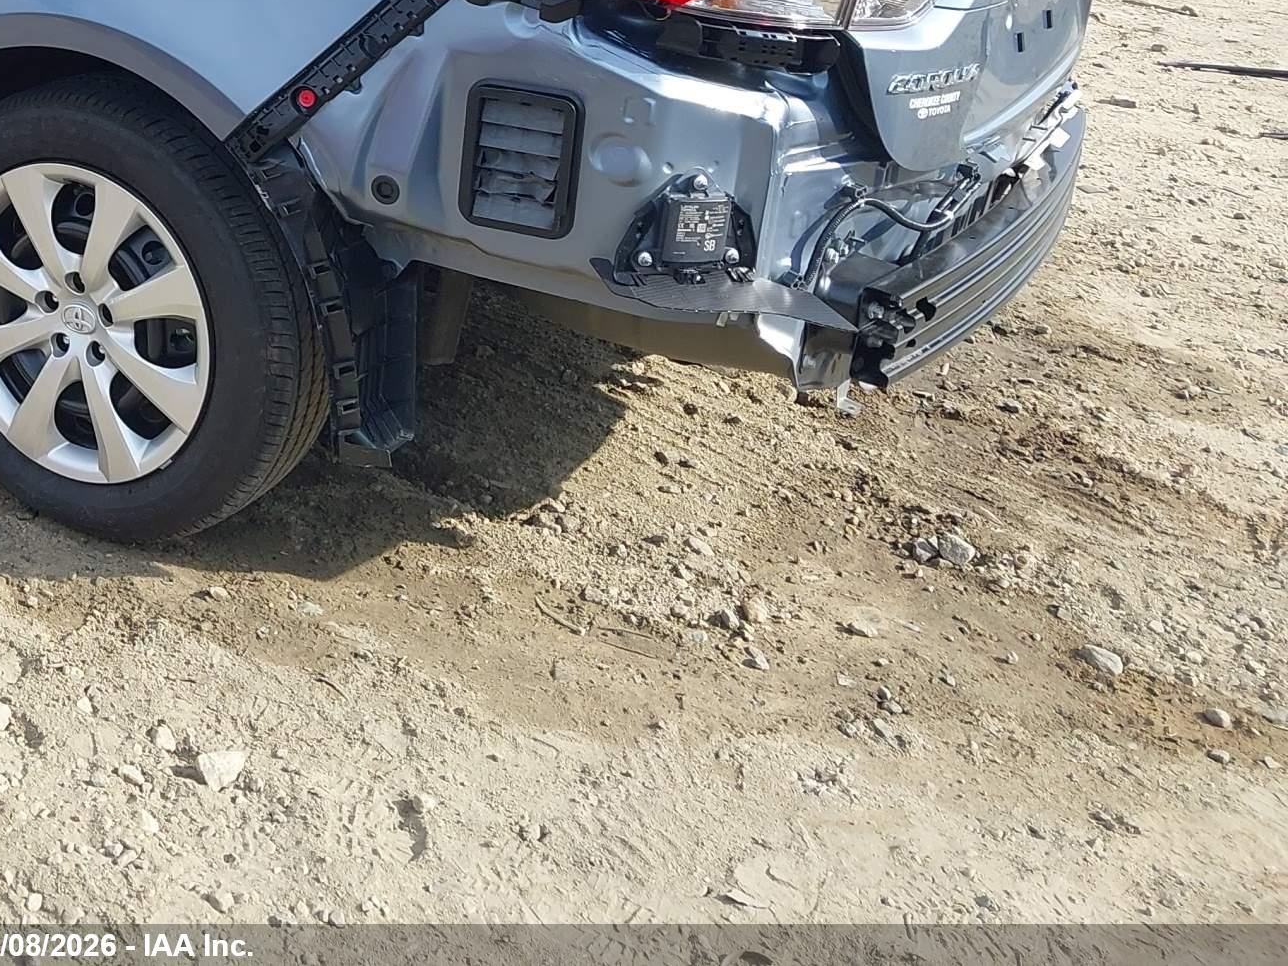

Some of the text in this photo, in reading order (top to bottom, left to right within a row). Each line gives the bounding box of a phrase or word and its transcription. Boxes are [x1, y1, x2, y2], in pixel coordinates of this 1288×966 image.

[887, 63, 981, 95] COROLLA
[909, 91, 961, 109] CHEROKEE COUNTY
[928, 105, 951, 116] TOYOTA
[703, 239, 716, 252] SB
